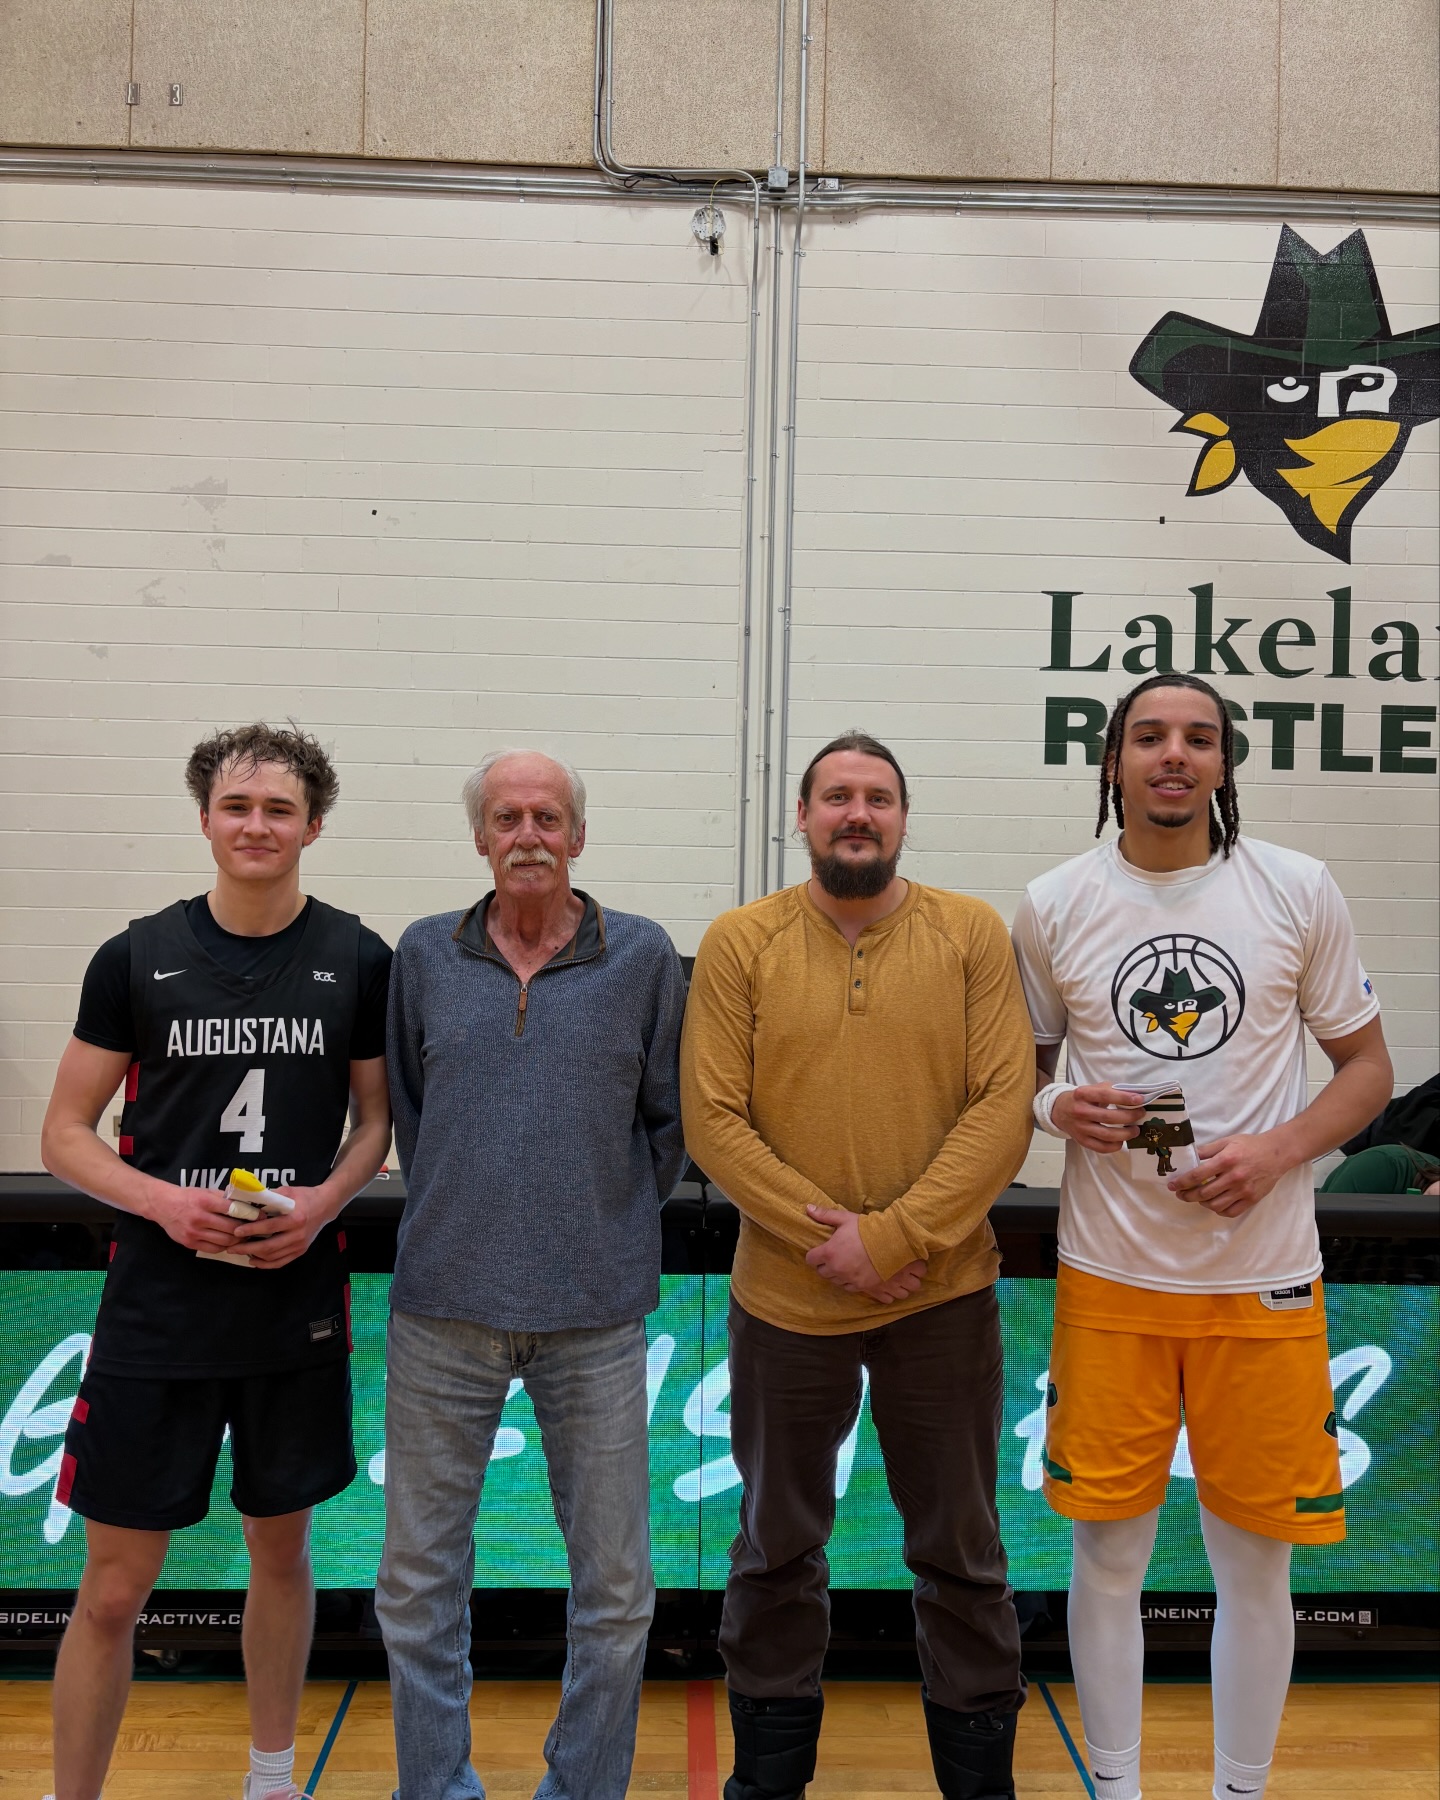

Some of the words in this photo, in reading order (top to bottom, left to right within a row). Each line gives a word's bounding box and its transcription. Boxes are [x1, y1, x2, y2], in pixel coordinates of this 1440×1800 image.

[1039, 582, 1438, 682] Lakela
[1044, 696, 1437, 774] RTLE
[166, 1017, 325, 1058] AUGUSTANA
[219, 1068, 266, 1153] 4
